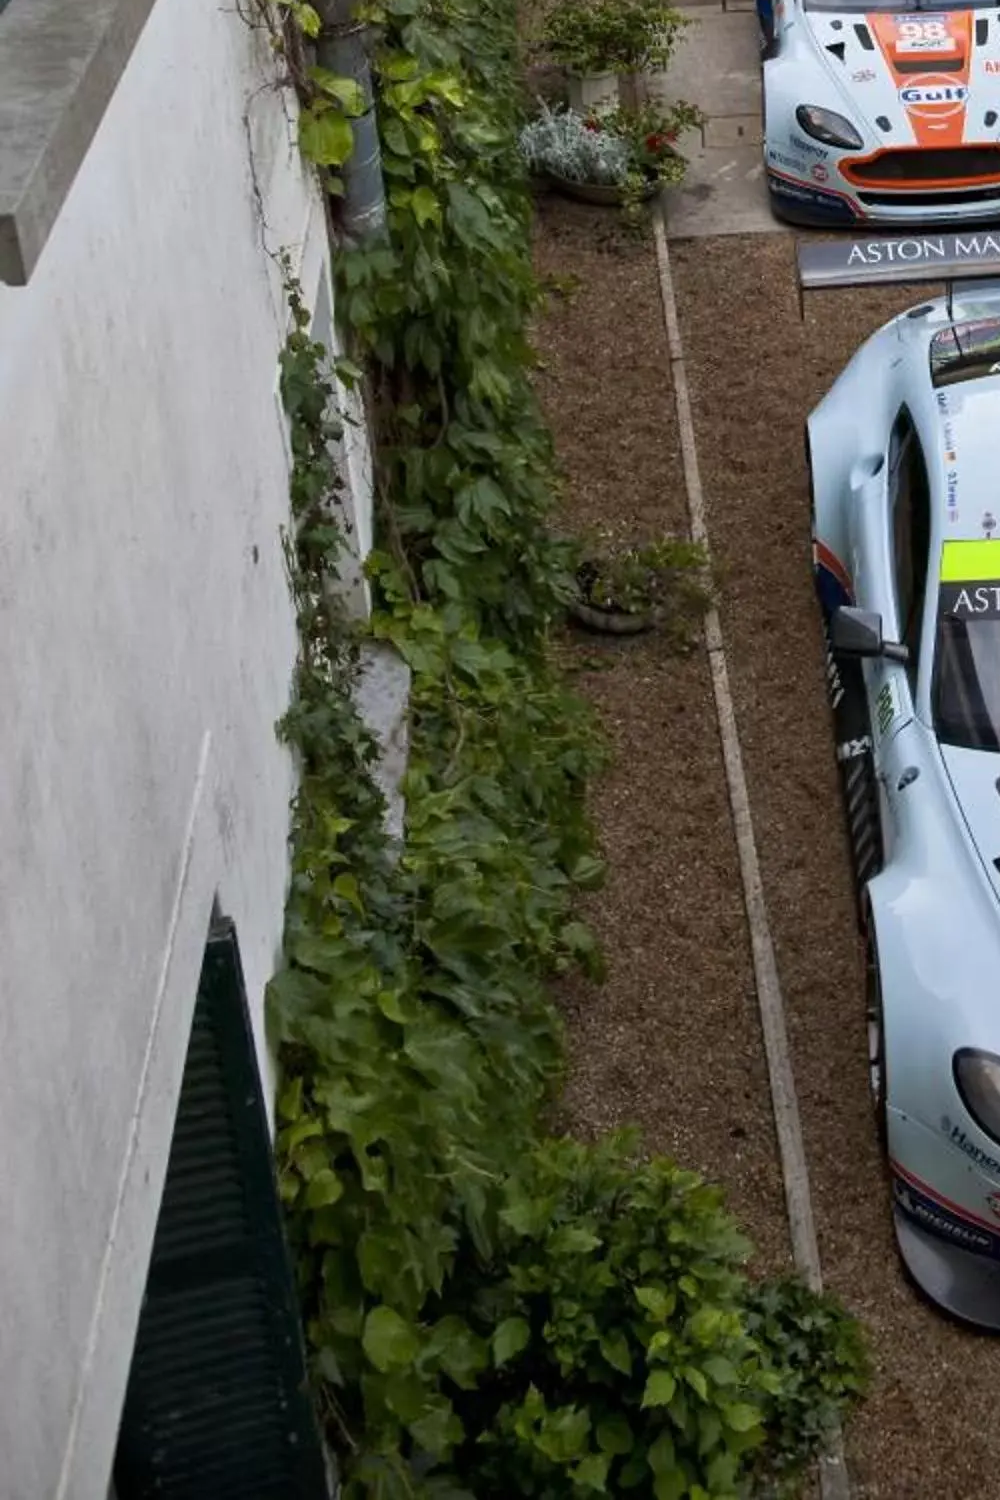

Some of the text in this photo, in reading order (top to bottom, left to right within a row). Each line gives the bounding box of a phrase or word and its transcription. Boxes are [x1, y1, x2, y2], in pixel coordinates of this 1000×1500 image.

[898, 22, 947, 40] 98
[901, 86, 967, 102] Gulf
[847, 238, 945, 265] ASTON
